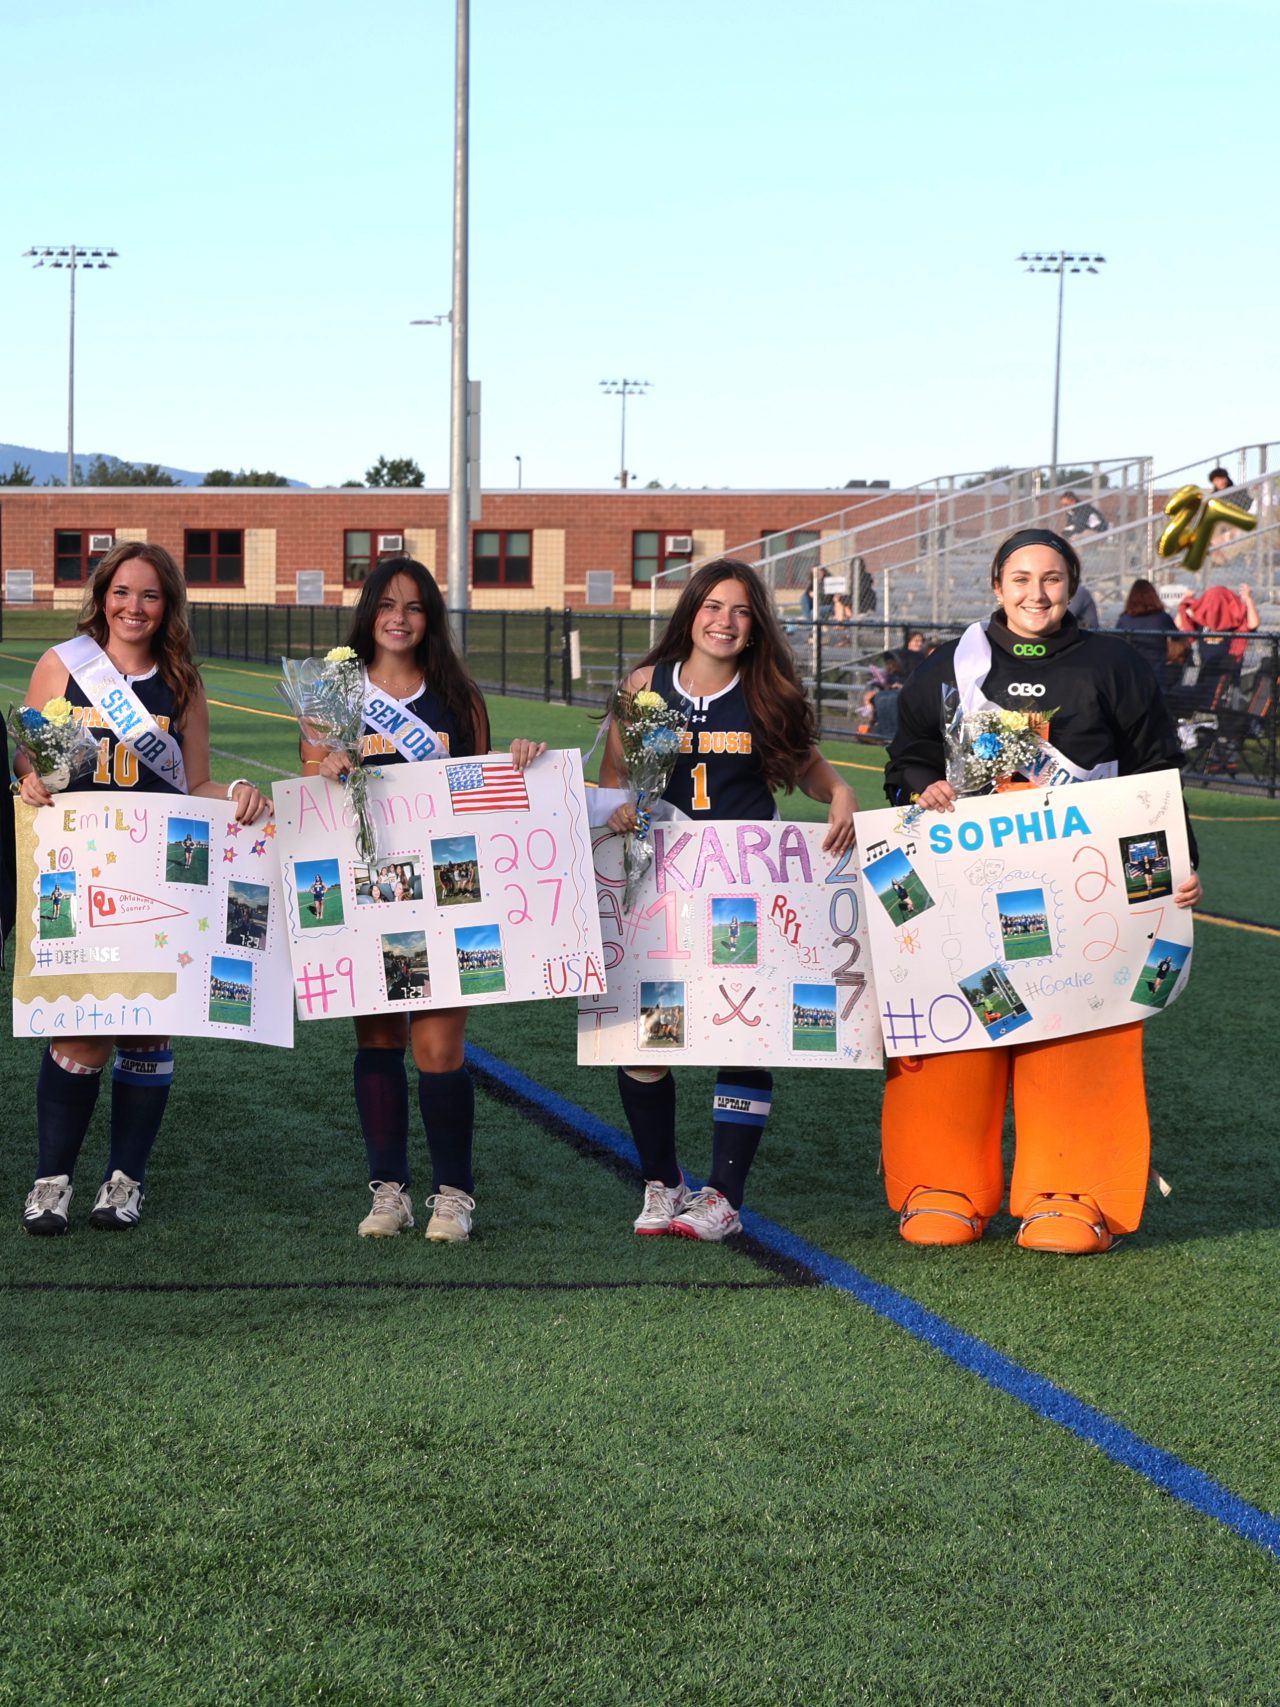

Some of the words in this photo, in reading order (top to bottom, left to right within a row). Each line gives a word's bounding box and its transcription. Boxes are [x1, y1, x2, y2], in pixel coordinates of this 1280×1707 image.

[1013, 643, 1046, 656] OBO
[1007, 682, 1046, 697] OBO
[93, 737, 139, 787] 10
[698, 732, 752, 754] BUSH
[691, 763, 711, 810] 1
[653, 824, 813, 894] KARA
[770, 894, 802, 945] RPI
[296, 956, 357, 1014] #9
[546, 956, 605, 994] USA
[121, 1059, 158, 1074] CAPTAIN
